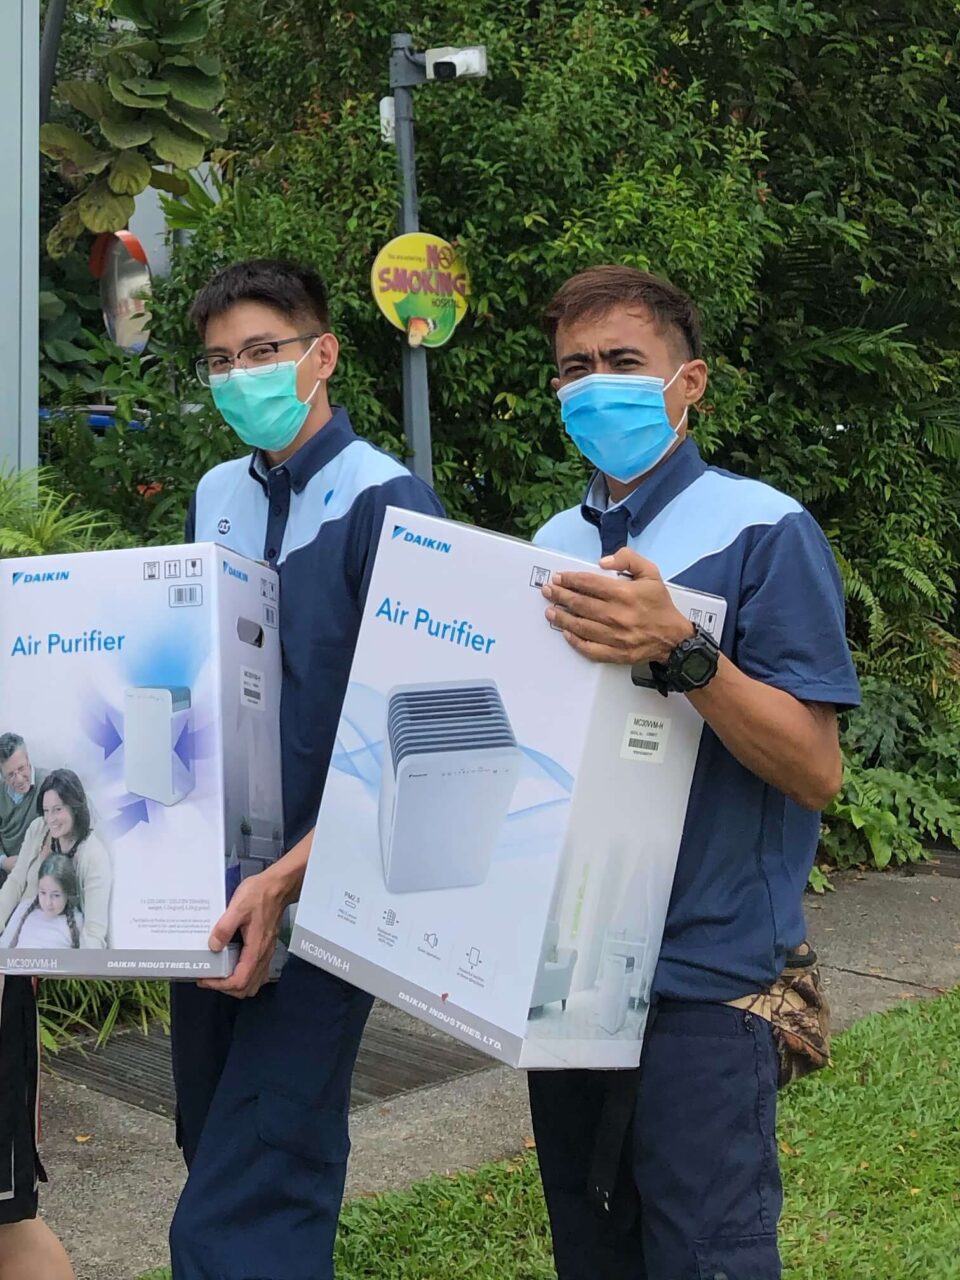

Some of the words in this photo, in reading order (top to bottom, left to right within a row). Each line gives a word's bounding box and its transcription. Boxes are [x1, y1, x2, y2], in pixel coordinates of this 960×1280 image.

[378, 267, 466, 297] SMOKING
[404, 532, 452, 554] DAIKIN
[23, 571, 70, 583] DAIKIN
[228, 566, 249, 582] DAIKIN
[375, 597, 409, 624] Air
[413, 608, 496, 654] Purifier
[10, 635, 42, 657] Air
[47, 629, 126, 655] Purifier
[6, 958, 58, 969] MC30VVM-H
[300, 938, 350, 973] MC30VVM-H
[398, 991, 428, 1011] DAIKIN
